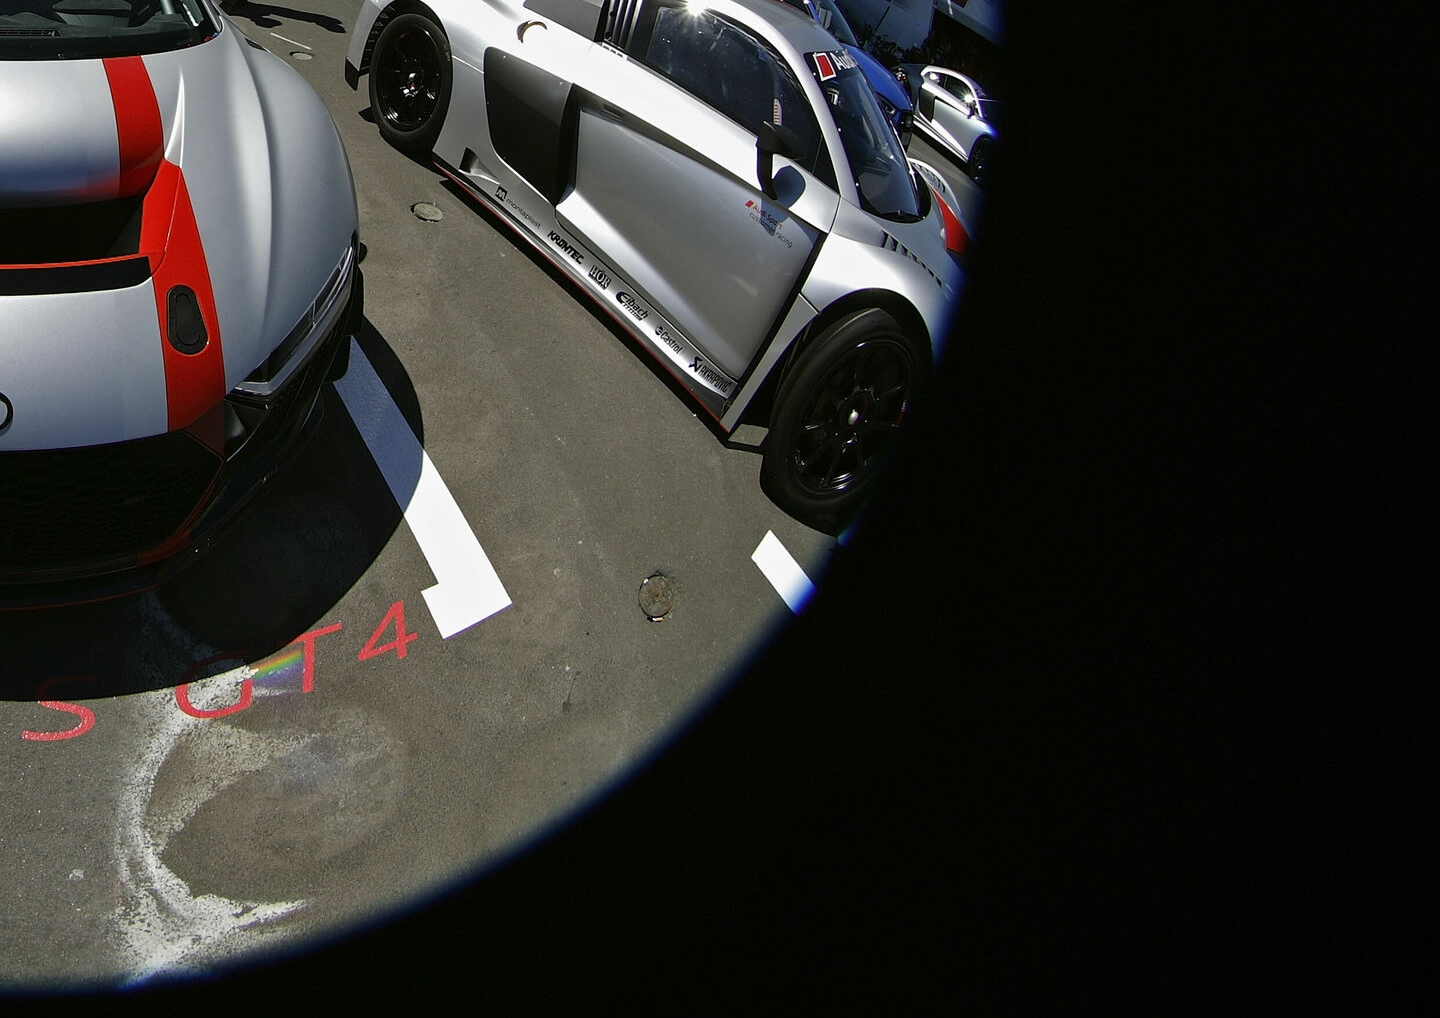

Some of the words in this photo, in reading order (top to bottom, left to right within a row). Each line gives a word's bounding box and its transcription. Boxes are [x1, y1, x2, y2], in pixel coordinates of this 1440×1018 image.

[506, 199, 541, 229] montaplast
[753, 205, 767, 218] Audi
[767, 214, 783, 230] Sport
[749, 212, 776, 235] customer
[776, 232, 793, 249] racing
[547, 230, 584, 264] KRONTEC
[616, 291, 649, 319] Eibach
[660, 331, 683, 354] Castrol
[176, 600, 418, 718] GT4
